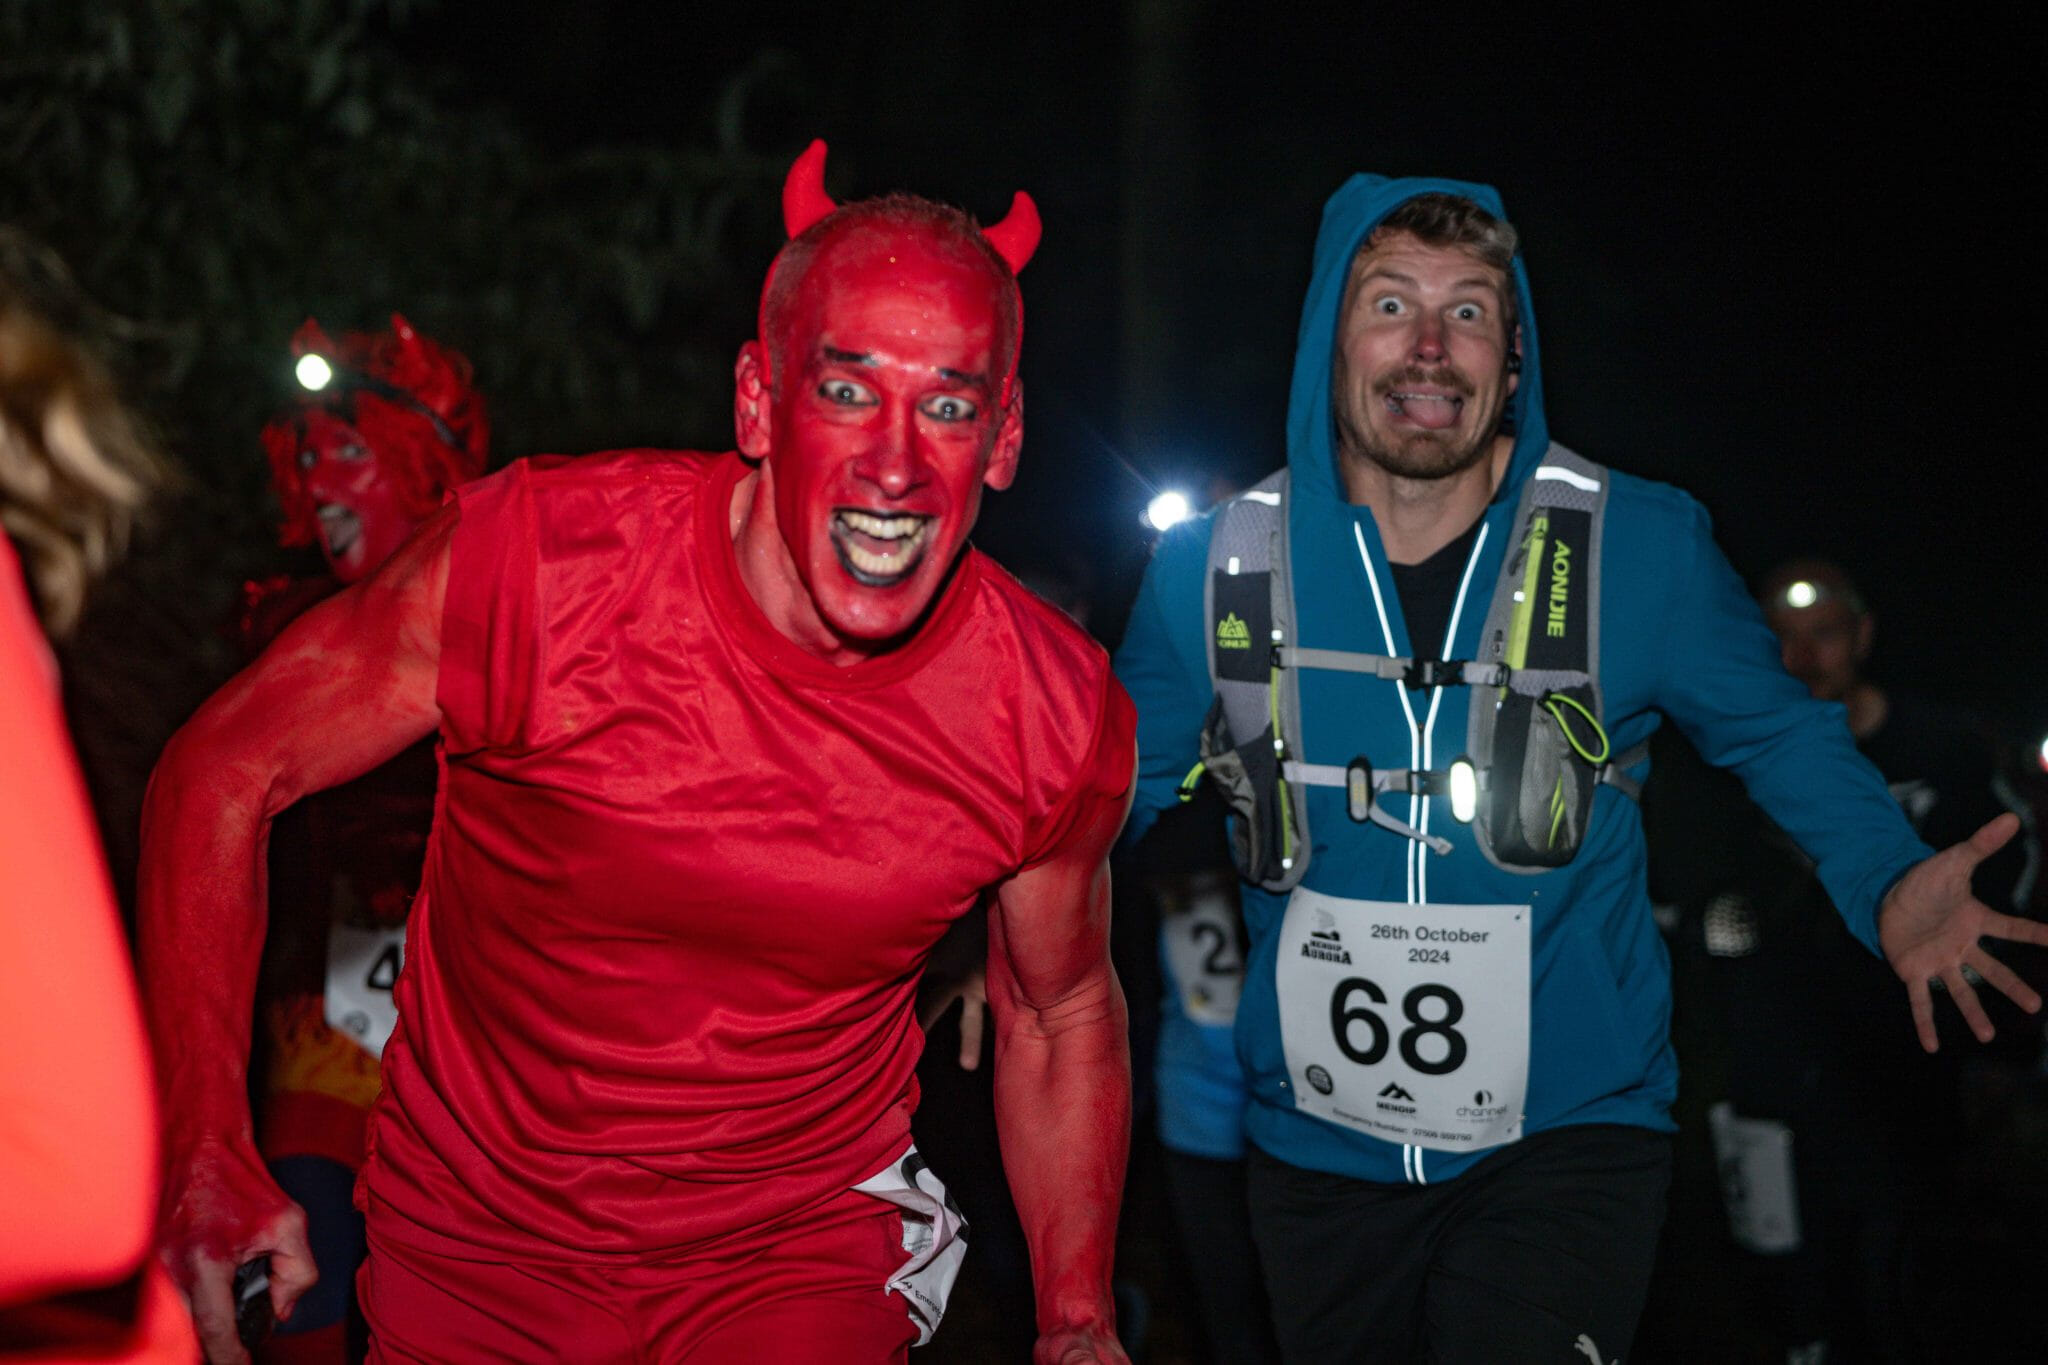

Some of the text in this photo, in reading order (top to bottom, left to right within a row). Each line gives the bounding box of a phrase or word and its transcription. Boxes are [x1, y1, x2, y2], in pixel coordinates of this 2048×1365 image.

[1547, 539, 1572, 638] AONIJIE
[1371, 924, 1489, 943] 26th October
[1301, 943, 1352, 965] AURORA
[1409, 948, 1450, 964] 2024
[1331, 977, 1467, 1076] 68
[1377, 1102, 1416, 1114] MENDIP
[1456, 1104, 1508, 1116] channel
